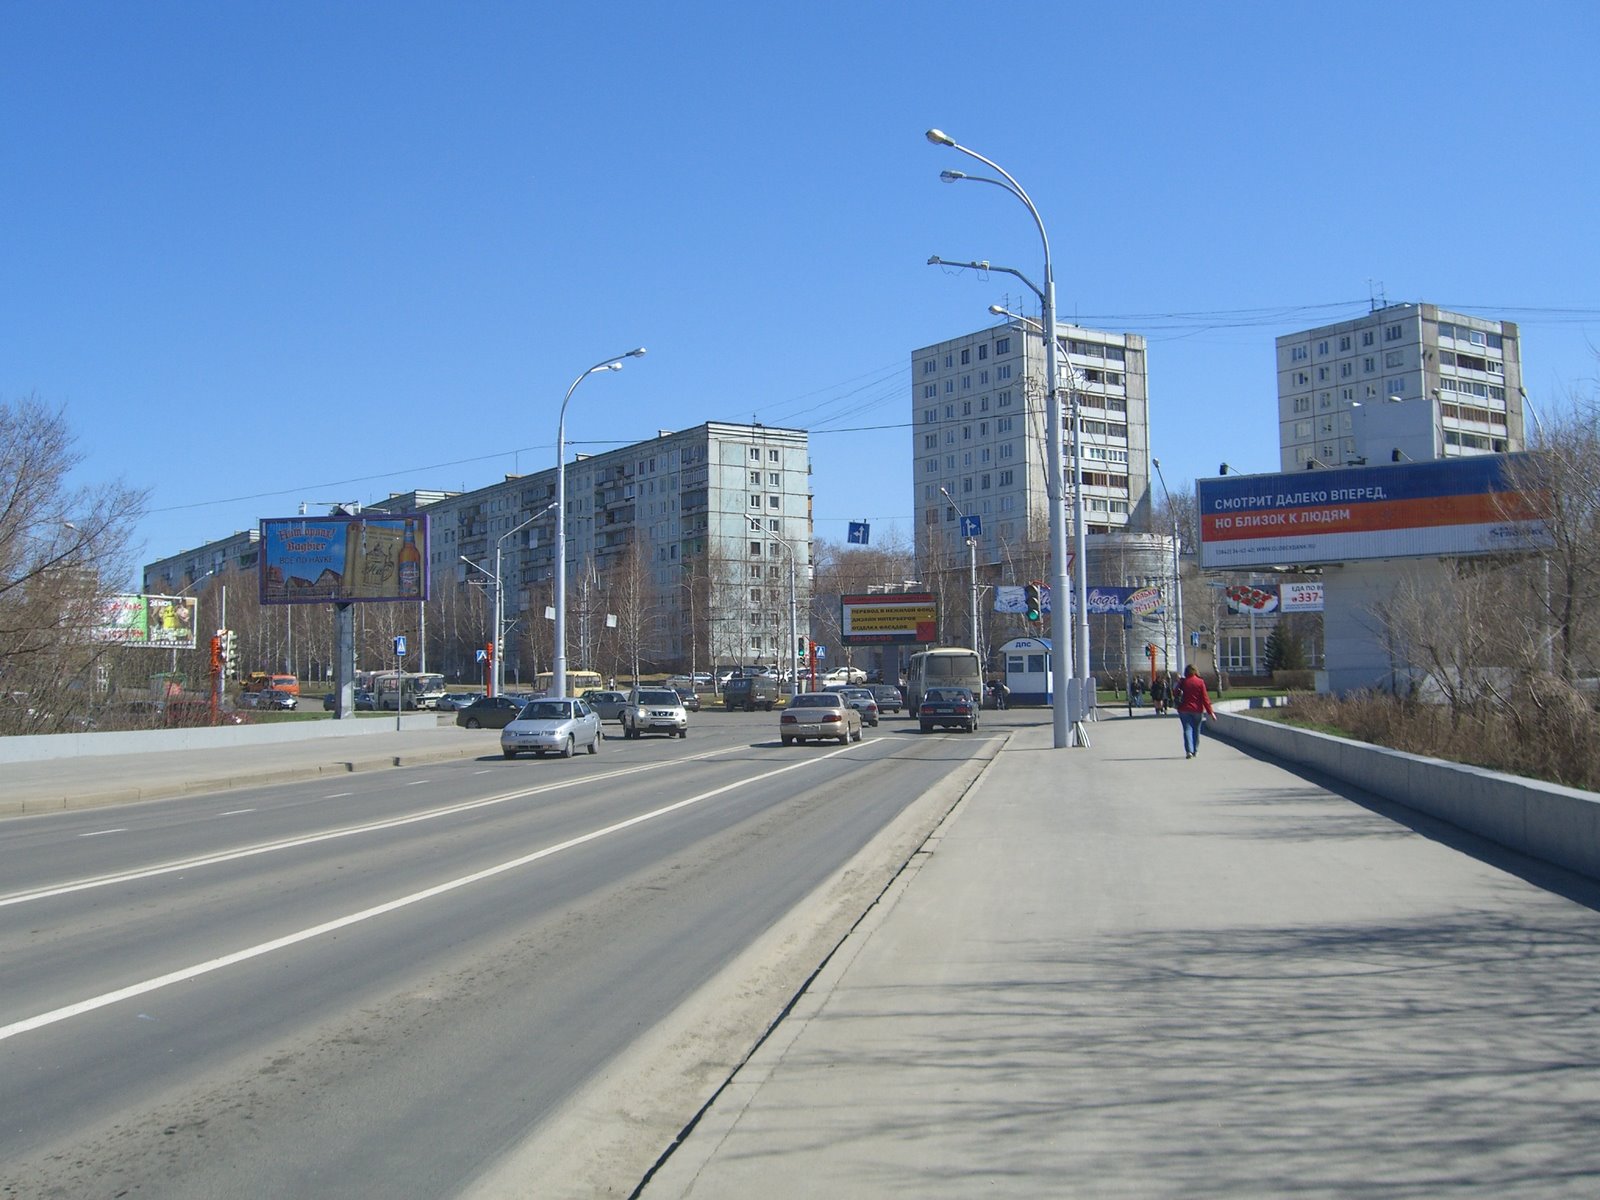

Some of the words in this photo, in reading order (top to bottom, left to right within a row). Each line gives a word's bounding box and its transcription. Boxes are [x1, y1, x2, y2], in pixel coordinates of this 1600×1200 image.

[1215, 495, 1273, 510] СМОТРИТ
[1276, 491, 1328, 507] ДАЛЕКО
[1331, 486, 1388, 501] ВПЕРЕД,
[1215, 518, 1232, 529] НО
[1235, 513, 1286, 528] БЛИЗОК
[1289, 513, 1298, 524] К
[1301, 509, 1350, 523] ЛЮДЯМ
[1131, 588, 1157, 602] ТОЛЬКО
